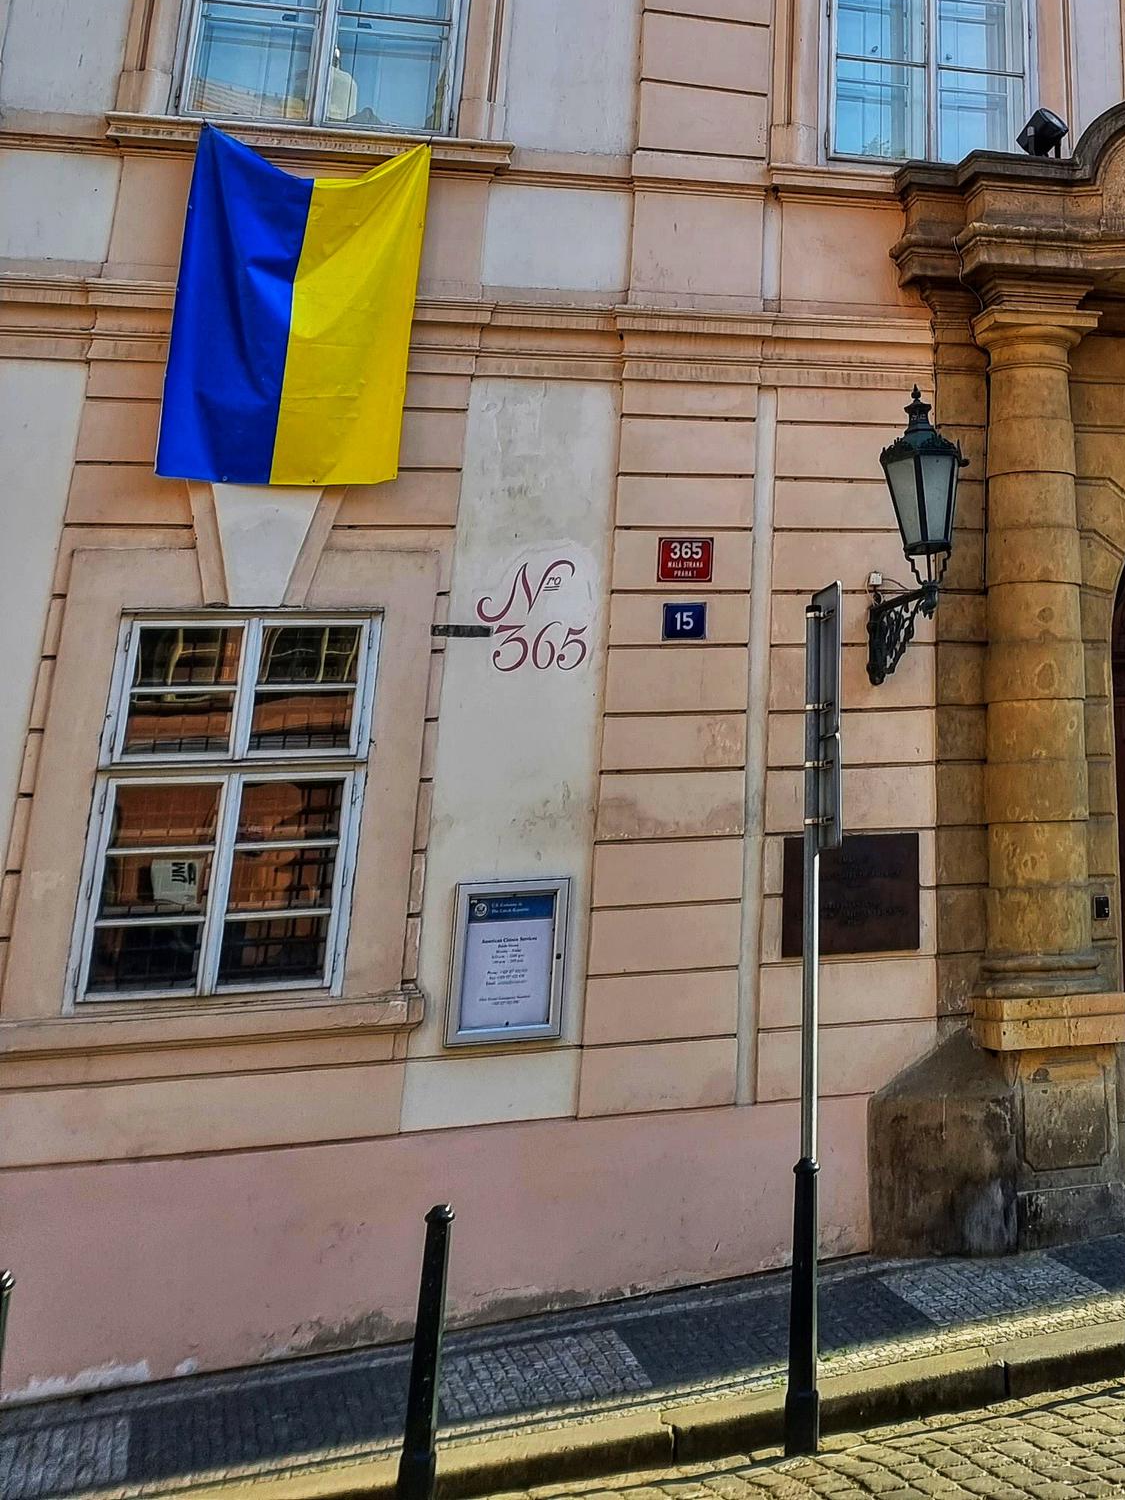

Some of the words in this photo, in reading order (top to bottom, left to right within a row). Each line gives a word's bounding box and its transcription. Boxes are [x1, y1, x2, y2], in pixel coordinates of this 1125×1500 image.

[670, 542, 703, 559] 365
[683, 561, 704, 569] STRANA
[675, 611, 694, 630] 15
[492, 621, 588, 672] 365
